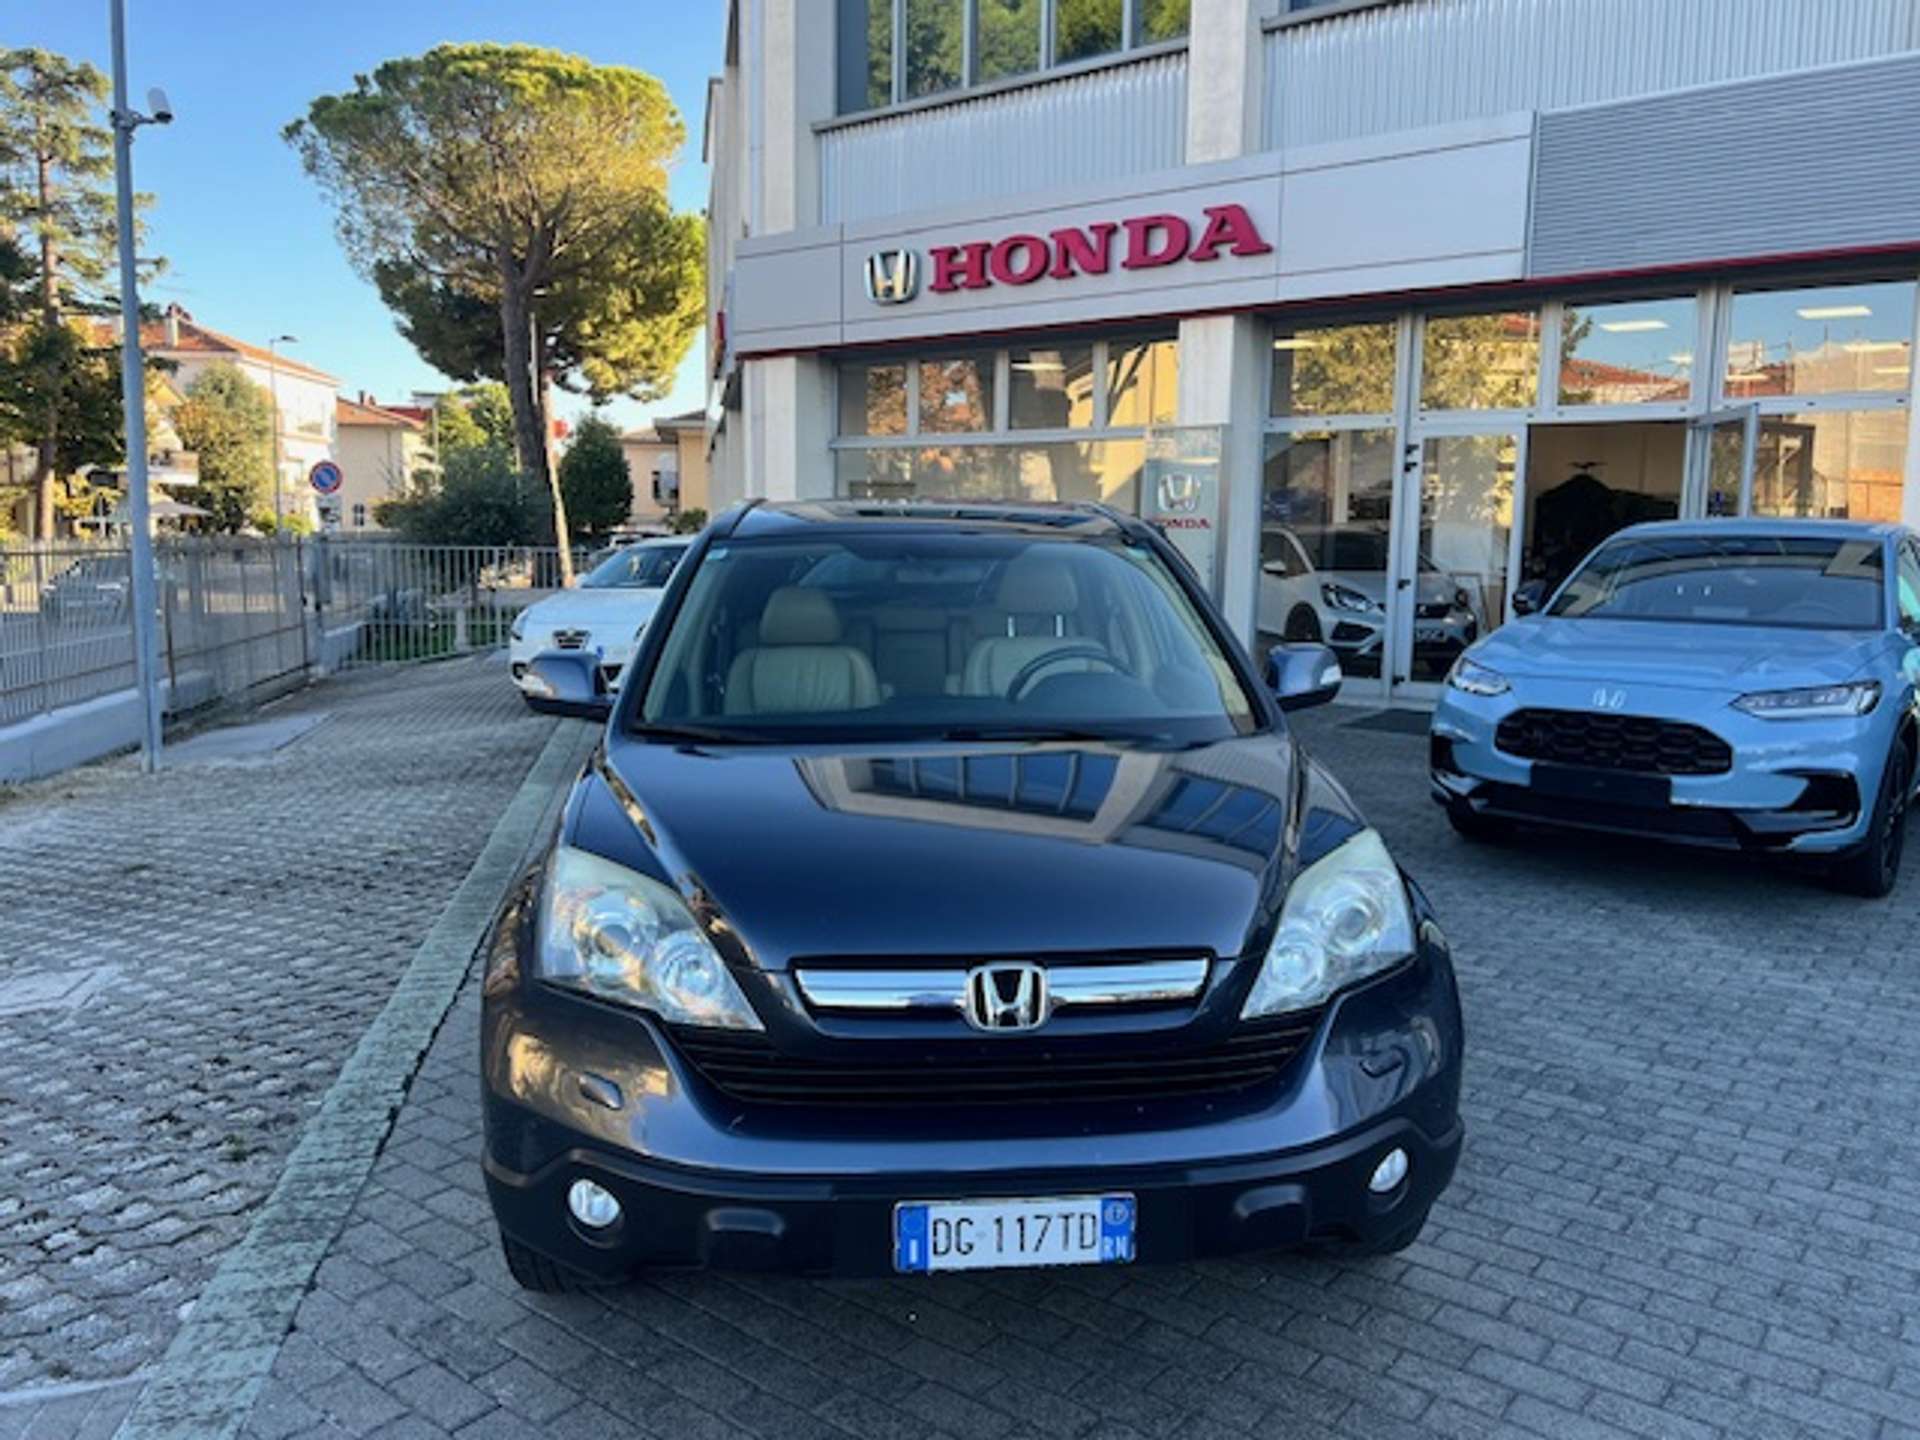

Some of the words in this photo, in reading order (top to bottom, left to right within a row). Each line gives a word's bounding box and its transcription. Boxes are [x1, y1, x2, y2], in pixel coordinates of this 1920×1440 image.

[929, 204, 1273, 292] HONDA
[1157, 517, 1211, 530] ONDA
[932, 1216, 975, 1256] DG
[993, 1212, 1098, 1254] 117TD
